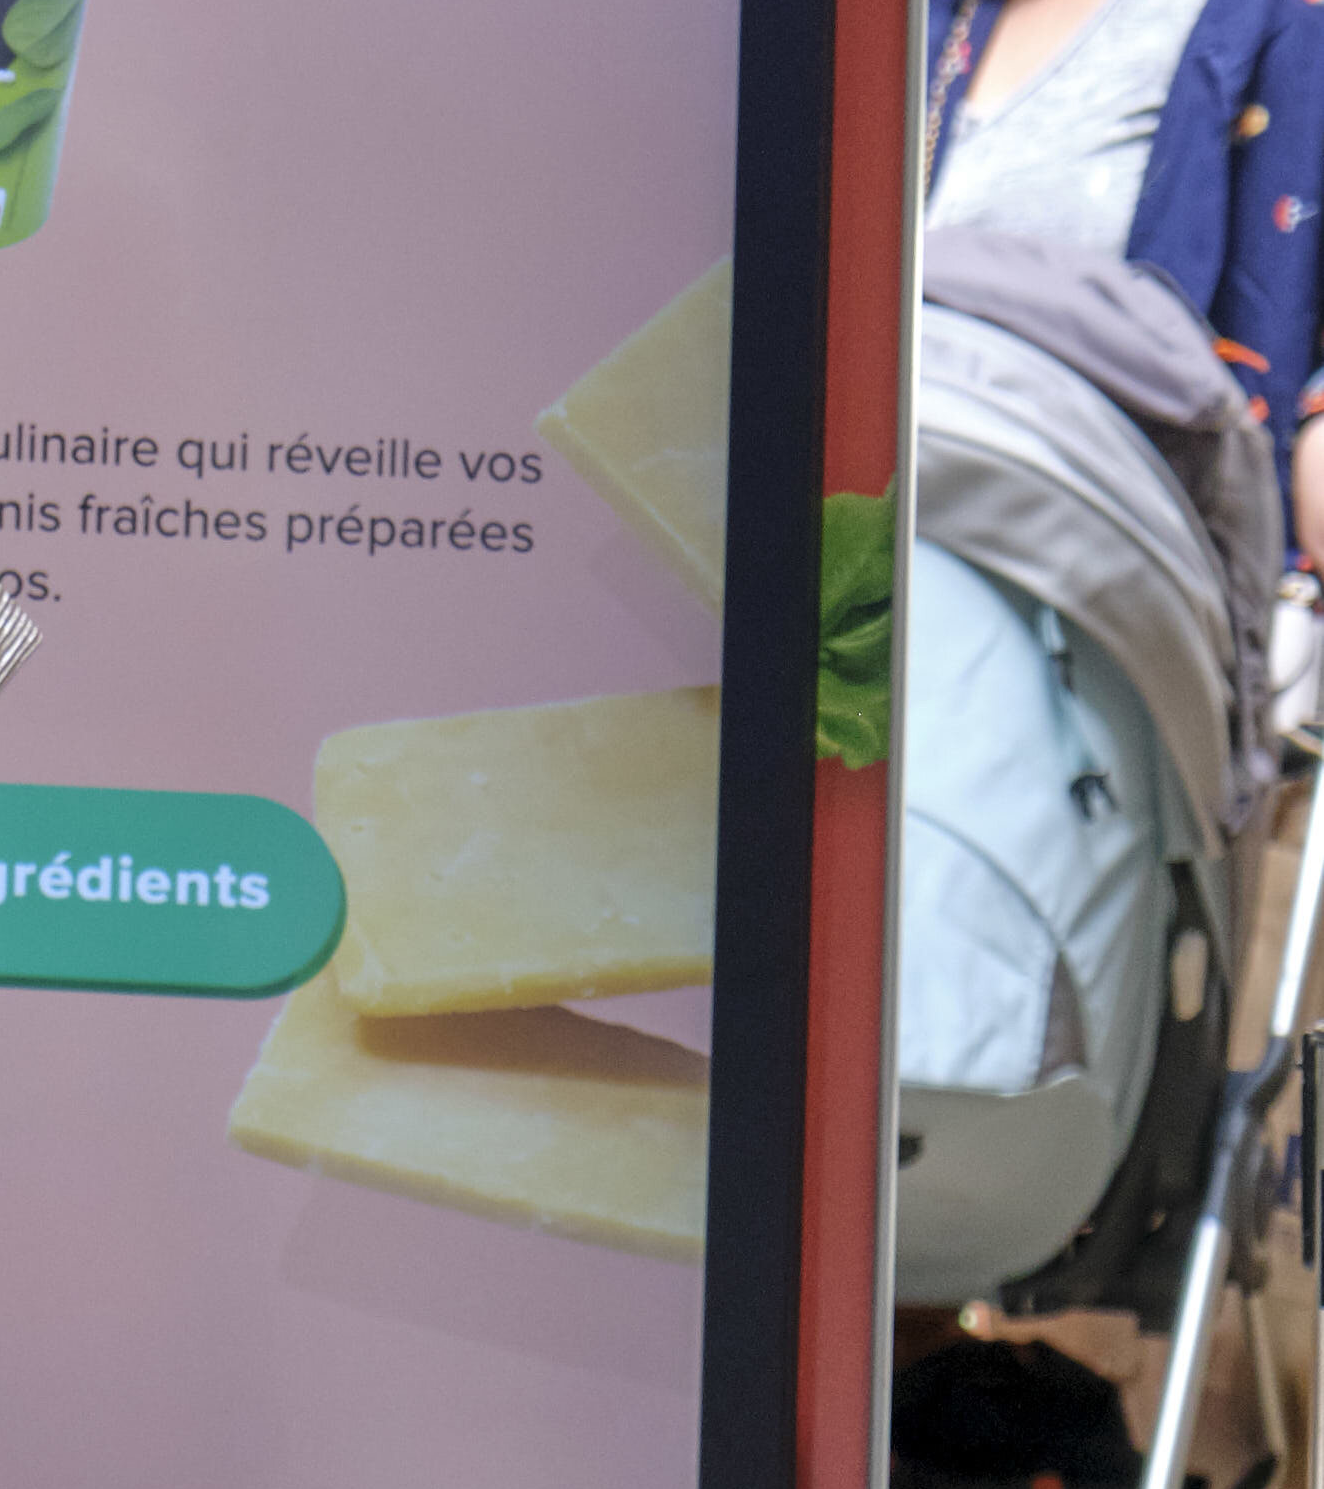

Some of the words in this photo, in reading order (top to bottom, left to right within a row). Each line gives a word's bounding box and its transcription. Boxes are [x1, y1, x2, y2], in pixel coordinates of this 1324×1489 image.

[177, 431, 250, 478] qui
[267, 432, 443, 481] réveille
[459, 448, 545, 485] vos
[79, 493, 268, 543] fraîches
[285, 508, 536, 557] préparées
